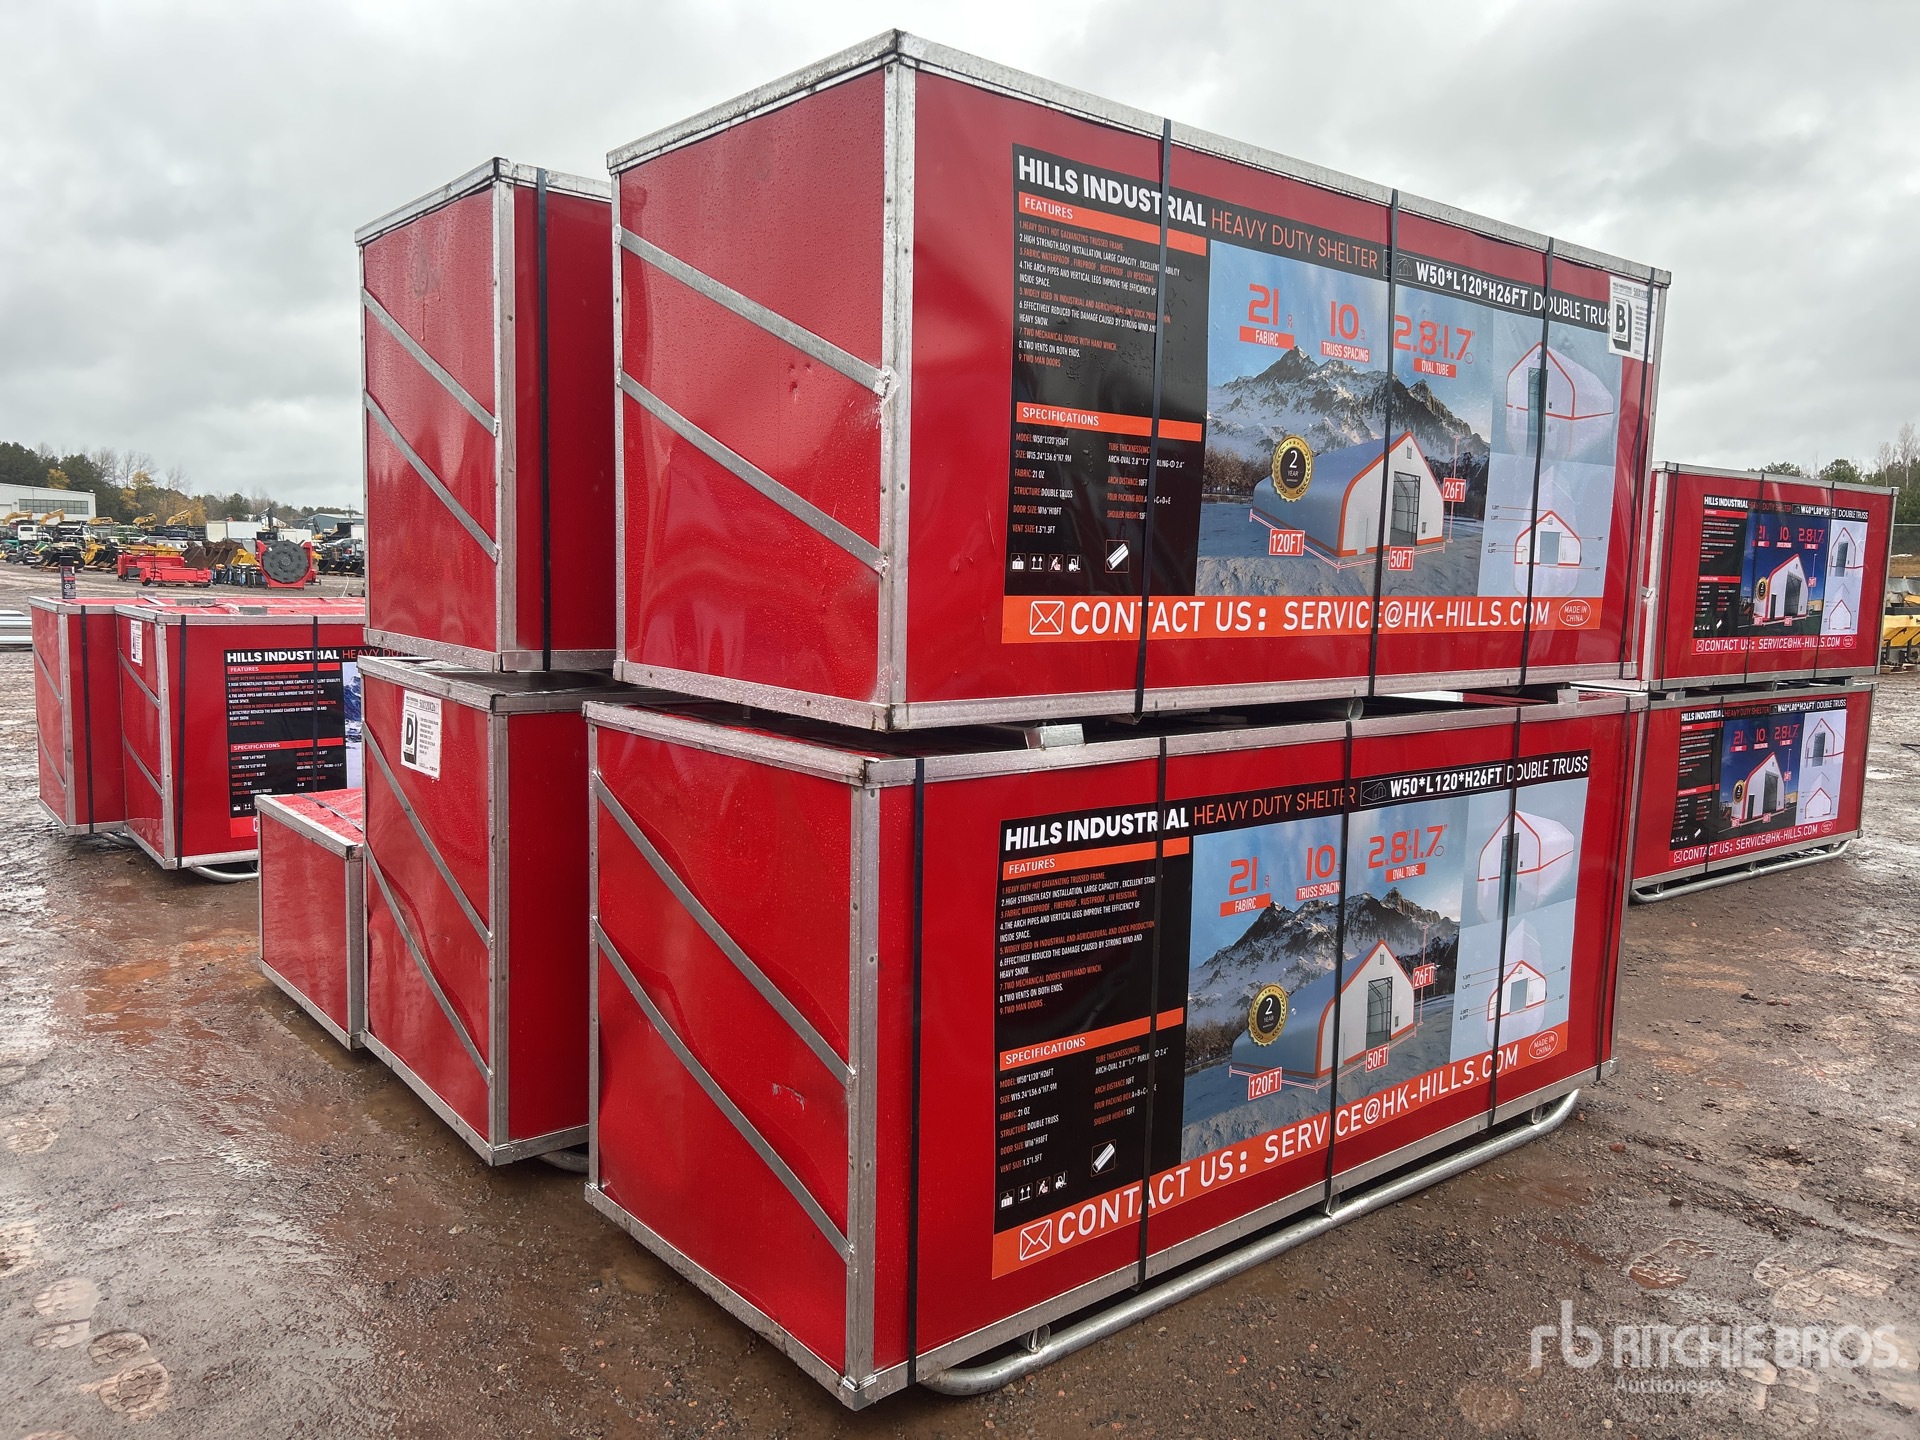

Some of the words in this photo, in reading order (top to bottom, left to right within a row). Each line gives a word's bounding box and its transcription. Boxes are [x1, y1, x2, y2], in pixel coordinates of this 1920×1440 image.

[1018, 155, 1078, 194] HILLS
[1083, 174, 1207, 228] INDUSTRIAL
[1025, 197, 1073, 221] FEATURES
[1211, 208, 1267, 242] HEAVY
[1272, 224, 1314, 253] DUTY
[1318, 237, 1378, 270] SHELTER
[1248, 283, 1279, 326] 21
[1330, 301, 1359, 340] 10
[1616, 304, 1626, 333] B
[1255, 330, 1279, 347] FABIRC
[1323, 342, 1343, 357] TRUSS
[1344, 345, 1370, 362] SPACING
[1421, 360, 1435, 374] OVAL
[1436, 362, 1449, 376] TUBE
[1022, 405, 1099, 426] SPECIFICATIONS
[1289, 450, 1298, 469] 2
[1445, 482, 1465, 499] 26FT
[1704, 496, 1719, 506] HILLS
[1719, 497, 1749, 509] INDUSTRIAL
[1838, 508, 1855, 518] DOUBLE
[1855, 510, 1869, 520] TRUSS
[1271, 533, 1303, 553] 120FT
[1780, 526, 1789, 541] 10
[1391, 550, 1413, 568] 50FT
[1071, 601, 1206, 635] CONACT
[1215, 601, 1267, 632] US:
[1282, 600, 1550, 631] SERVICE@HK-HILLS.COM
[1564, 604, 1580, 615] MADE
[1580, 604, 1588, 614] IN
[1565, 614, 1584, 623] CHINA
[1705, 638, 1739, 652] CONTACT
[226, 652, 262, 663] HILLS
[264, 649, 340, 663] INDUSTRIAL
[1816, 700, 1833, 710] DOUBLE
[1833, 699, 1847, 707] TRUSS
[1681, 711, 1695, 722] HILLS
[1695, 709, 1725, 720] INDUSTRIAL
[405, 717, 414, 746] D
[1733, 731, 1744, 745] 21
[1756, 728, 1766, 742] 10
[233, 743, 281, 751] SPECIFICATIONS
[1506, 759, 1549, 783] DOUBLE
[1552, 755, 1589, 776] TRUSS
[1194, 800, 1249, 826] HEAVY
[1253, 794, 1293, 818] DUTY
[1296, 786, 1357, 812] SHELTER
[1005, 821, 1063, 851] HILLS
[1682, 844, 1718, 862] CONTACT
[1719, 842, 1734, 853] US:
[1736, 825, 1818, 851] SERVICE@HK-HILLS.COM
[1009, 858, 1056, 875] FEATURES
[1306, 844, 1336, 881] 10
[1392, 866, 1406, 880] OVAL
[1405, 864, 1419, 877] TUBE
[1229, 856, 1258, 896] 21
[1298, 885, 1318, 900] TRUSS
[1319, 881, 1341, 896] SPACIN
[1235, 897, 1257, 913] FABIRC
[1414, 966, 1435, 987] 26FT
[1264, 997, 1273, 1015] 2
[1005, 1034, 1086, 1066] SPECIFICATIONS
[1533, 1037, 1548, 1050] MADE
[1547, 1034, 1555, 1045] IN
[1535, 1043, 1552, 1055] CHINA
[1367, 1047, 1388, 1070] 50FT
[1250, 1070, 1280, 1097] 120FT
[1057, 1166, 1191, 1244] CONTACT
[1200, 1151, 1247, 1187] US:
[1264, 1044, 1519, 1164] SERVCE@HK-HILLS.COM
